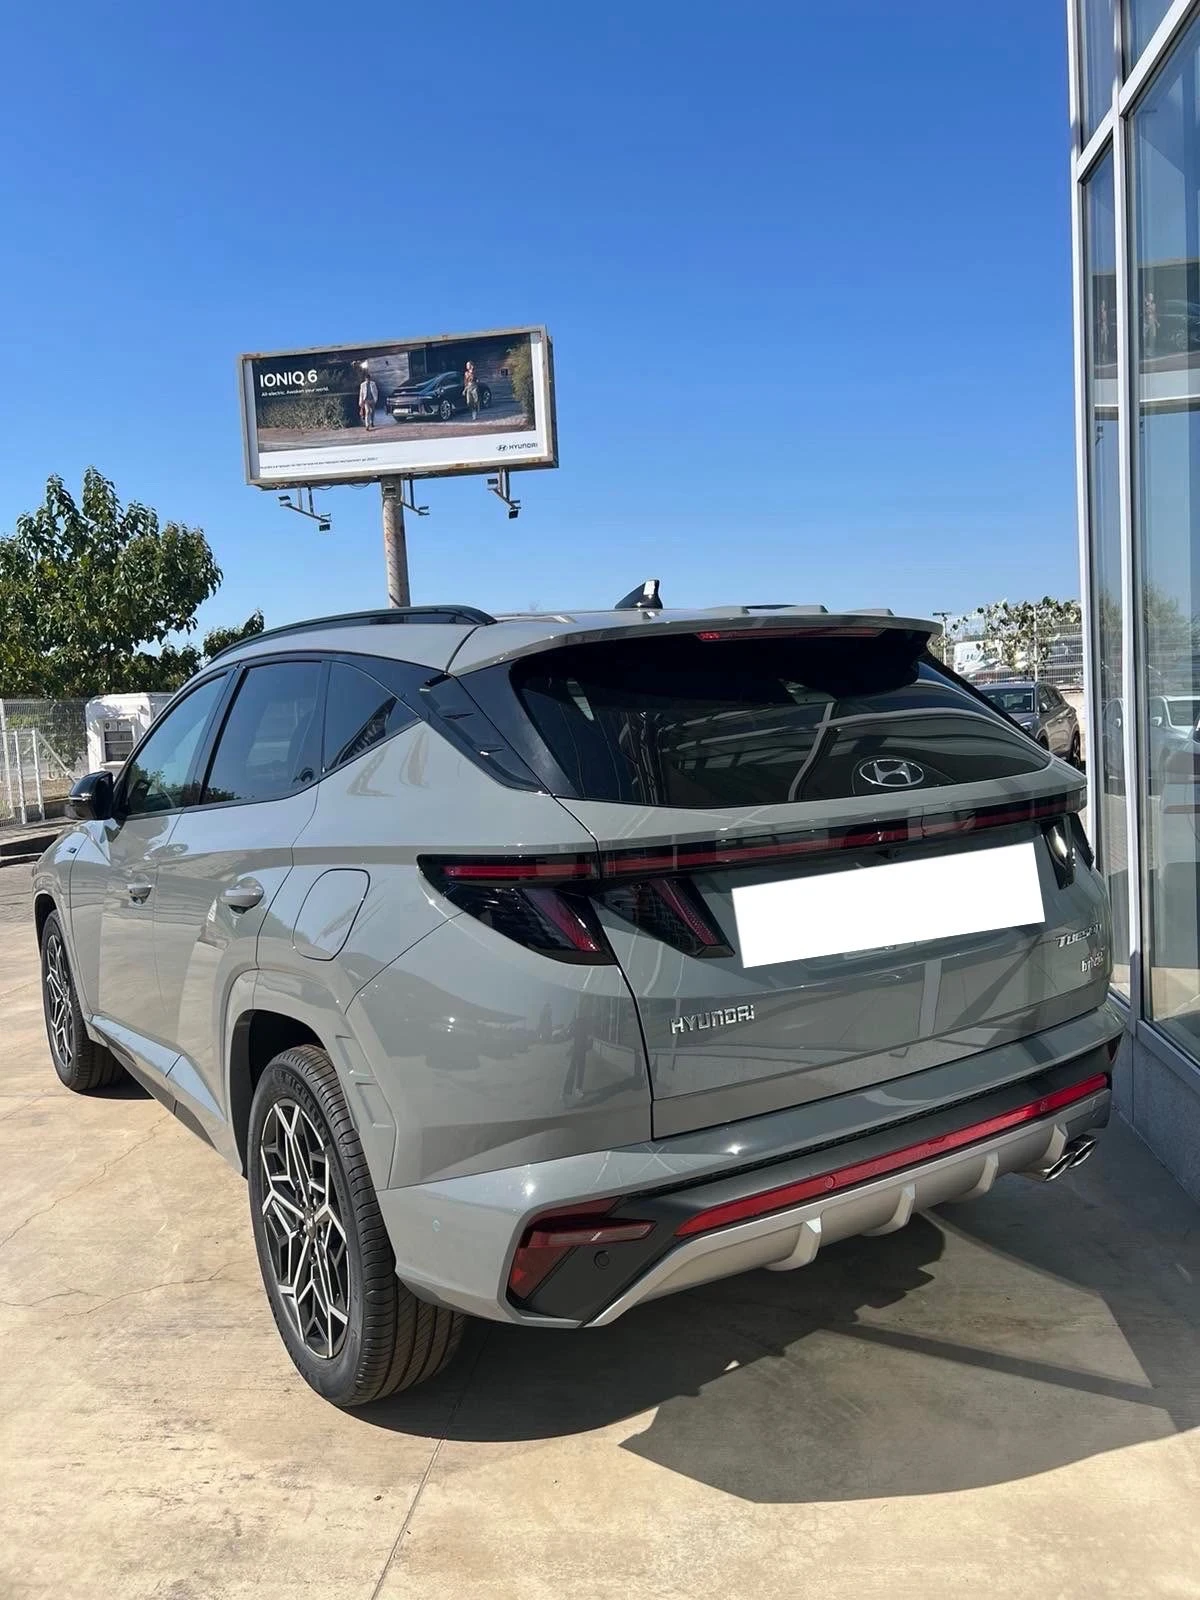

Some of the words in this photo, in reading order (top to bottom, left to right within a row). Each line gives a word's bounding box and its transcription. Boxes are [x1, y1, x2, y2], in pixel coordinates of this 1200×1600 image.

[260, 371, 305, 388] IONIQ
[307, 369, 318, 383] 6
[509, 442, 538, 450] HYUNDAI
[671, 1004, 755, 1034] HYUNDAI
[284, 1073, 330, 1144] MICHELIN
